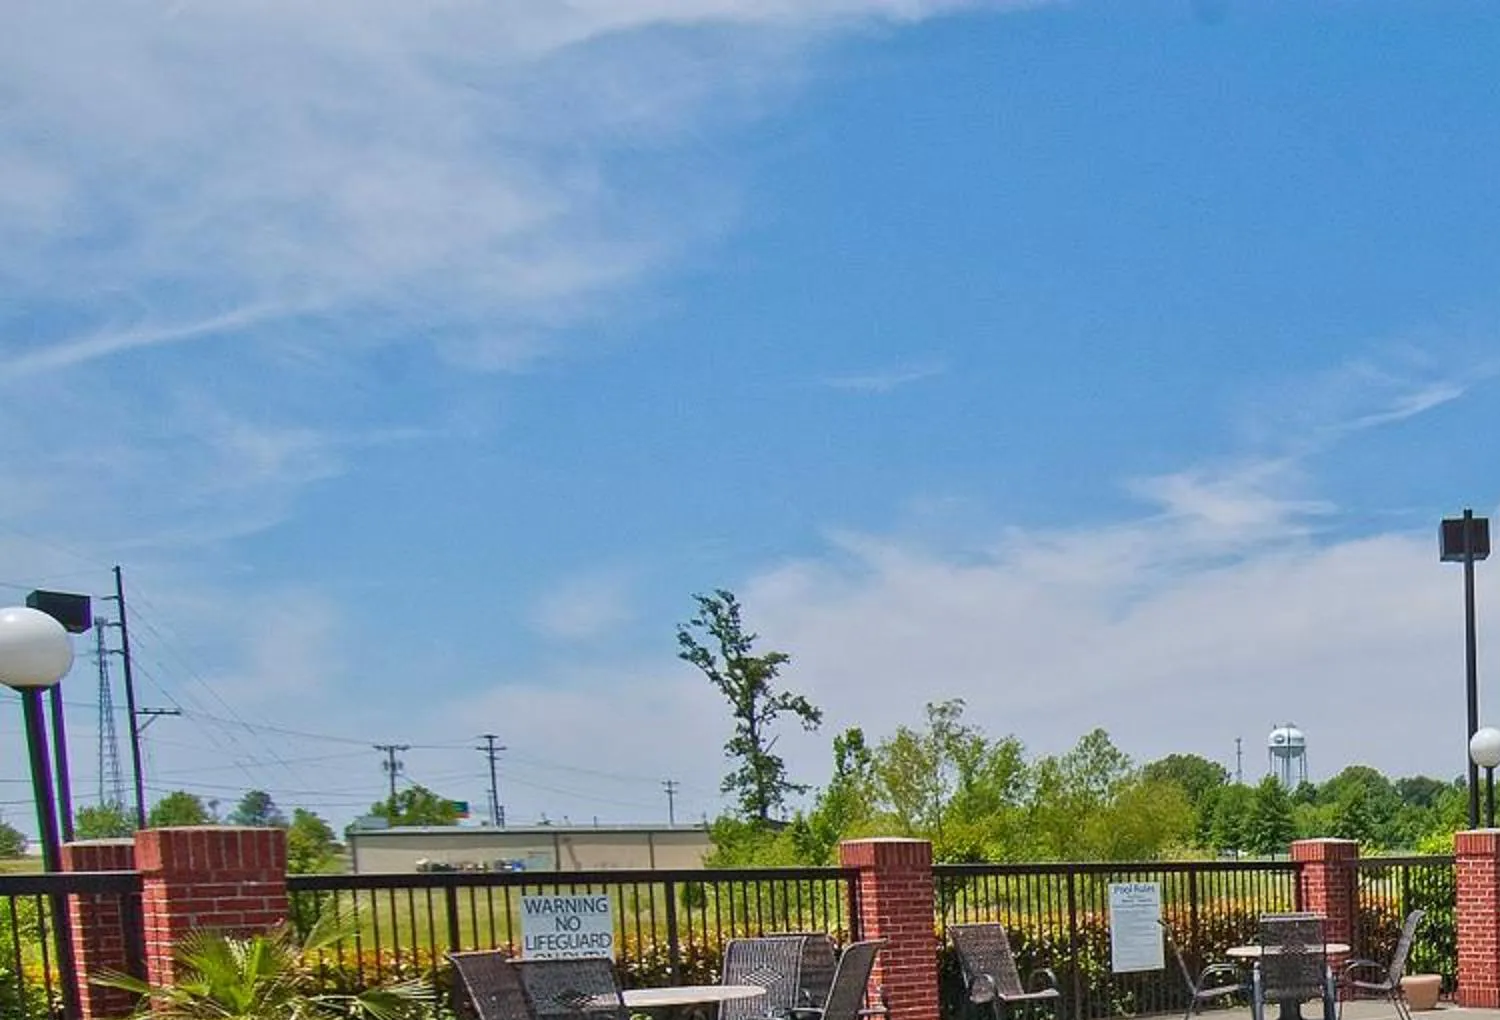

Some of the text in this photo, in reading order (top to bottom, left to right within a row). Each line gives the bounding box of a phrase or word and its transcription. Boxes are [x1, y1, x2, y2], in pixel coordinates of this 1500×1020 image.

[524, 898, 608, 914] WARNING
[555, 916, 581, 931] NO
[525, 933, 612, 950] LIFEGUARD
